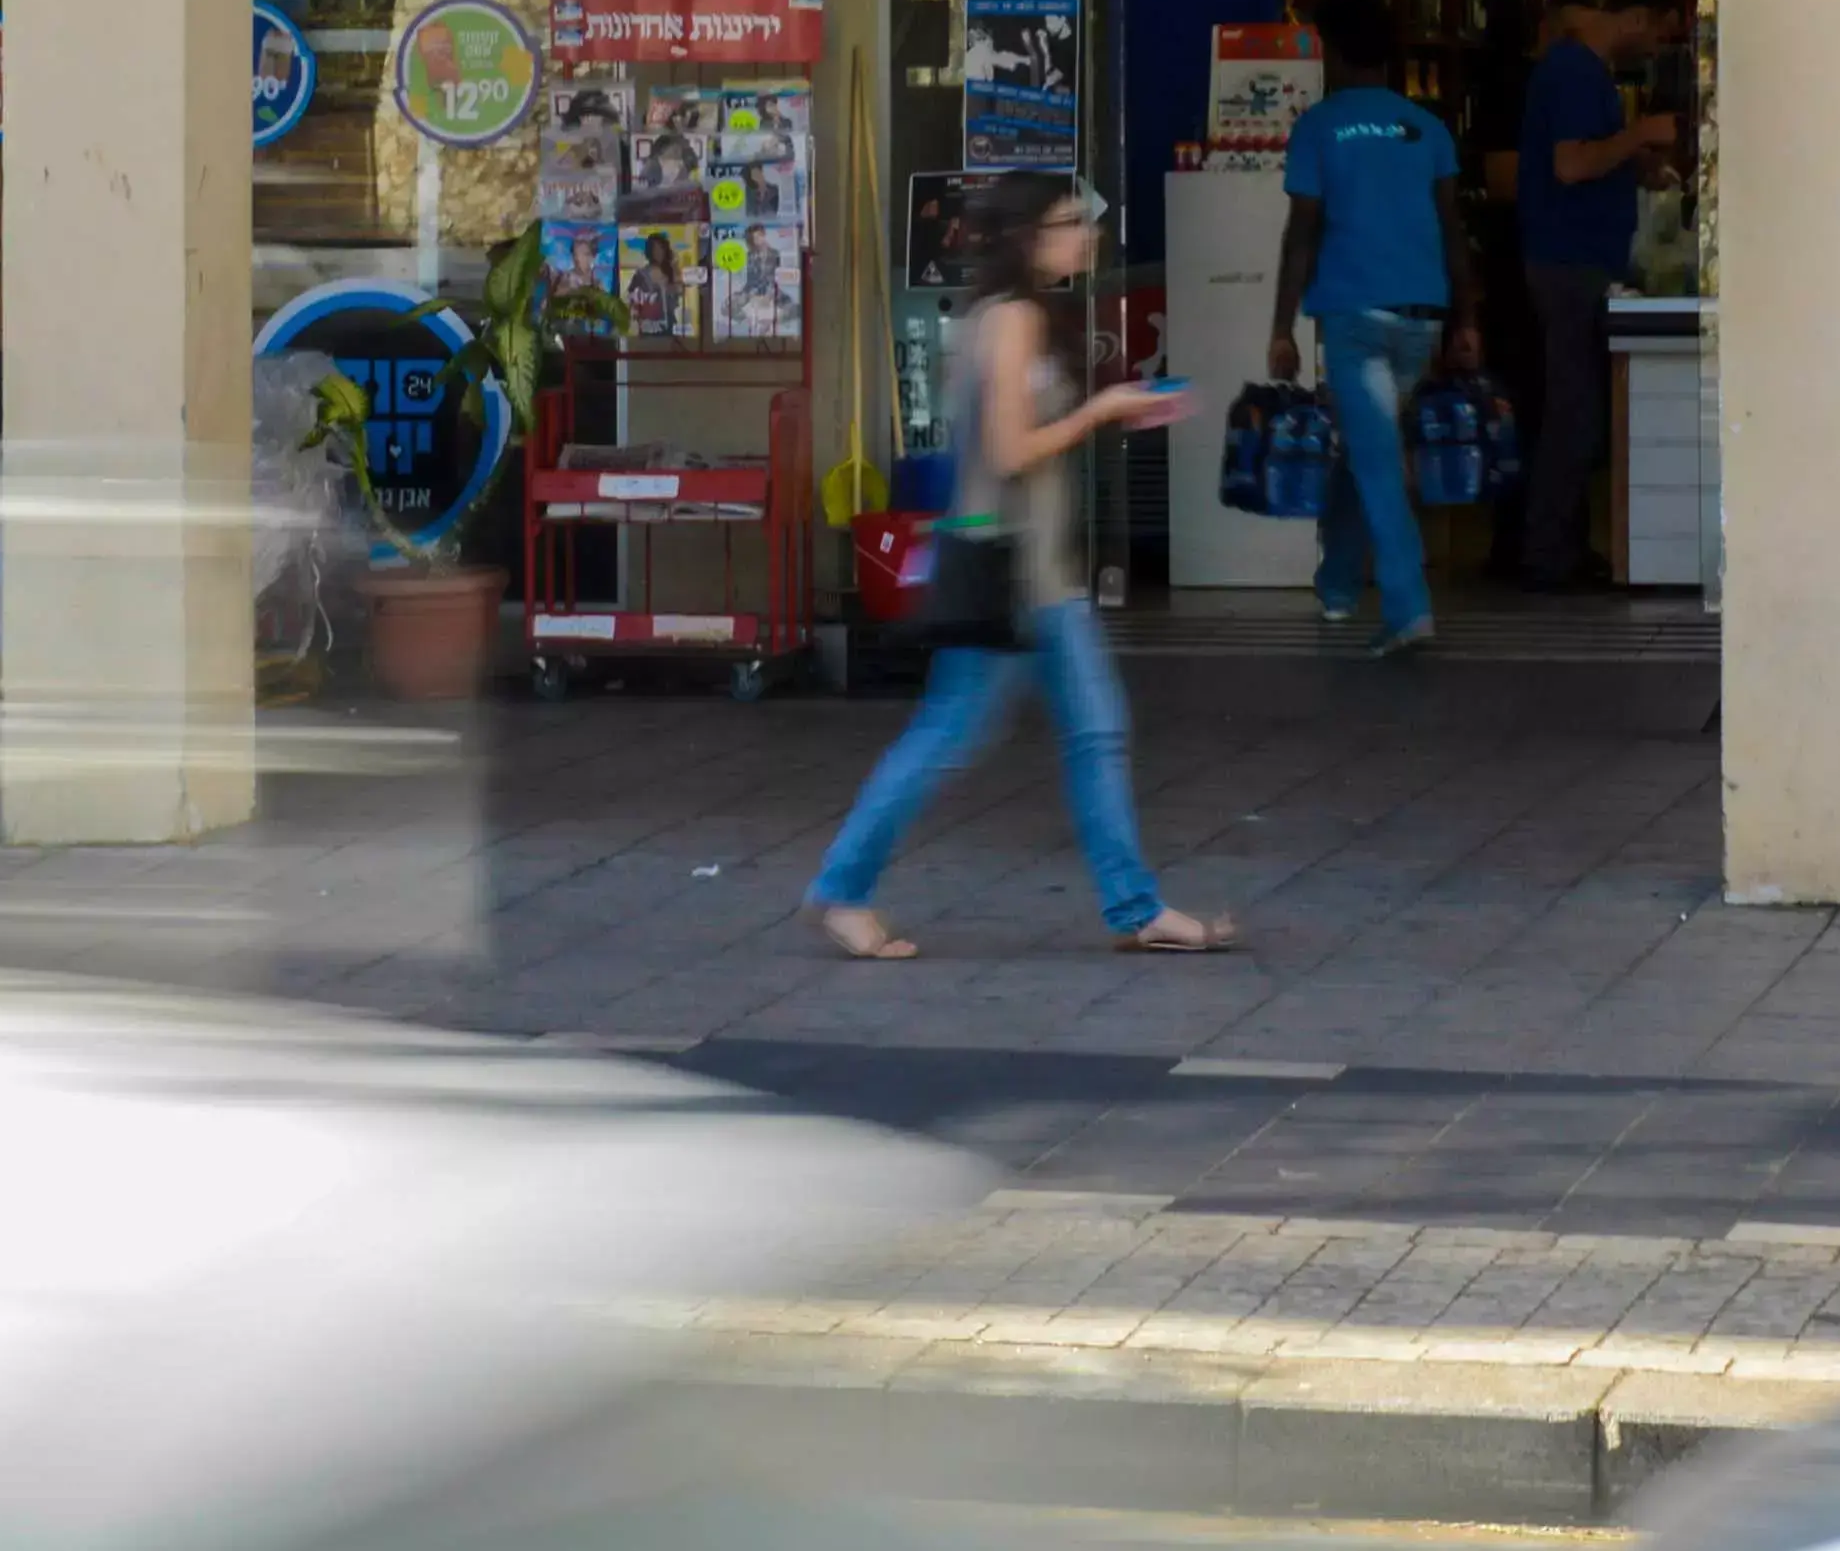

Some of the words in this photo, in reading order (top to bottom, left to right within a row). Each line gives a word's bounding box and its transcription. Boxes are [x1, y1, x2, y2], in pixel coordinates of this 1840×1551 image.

[584, 11, 684, 41] אחרונות
[689, 13, 782, 42] ידיעות
[408, 374, 432, 397] 24
